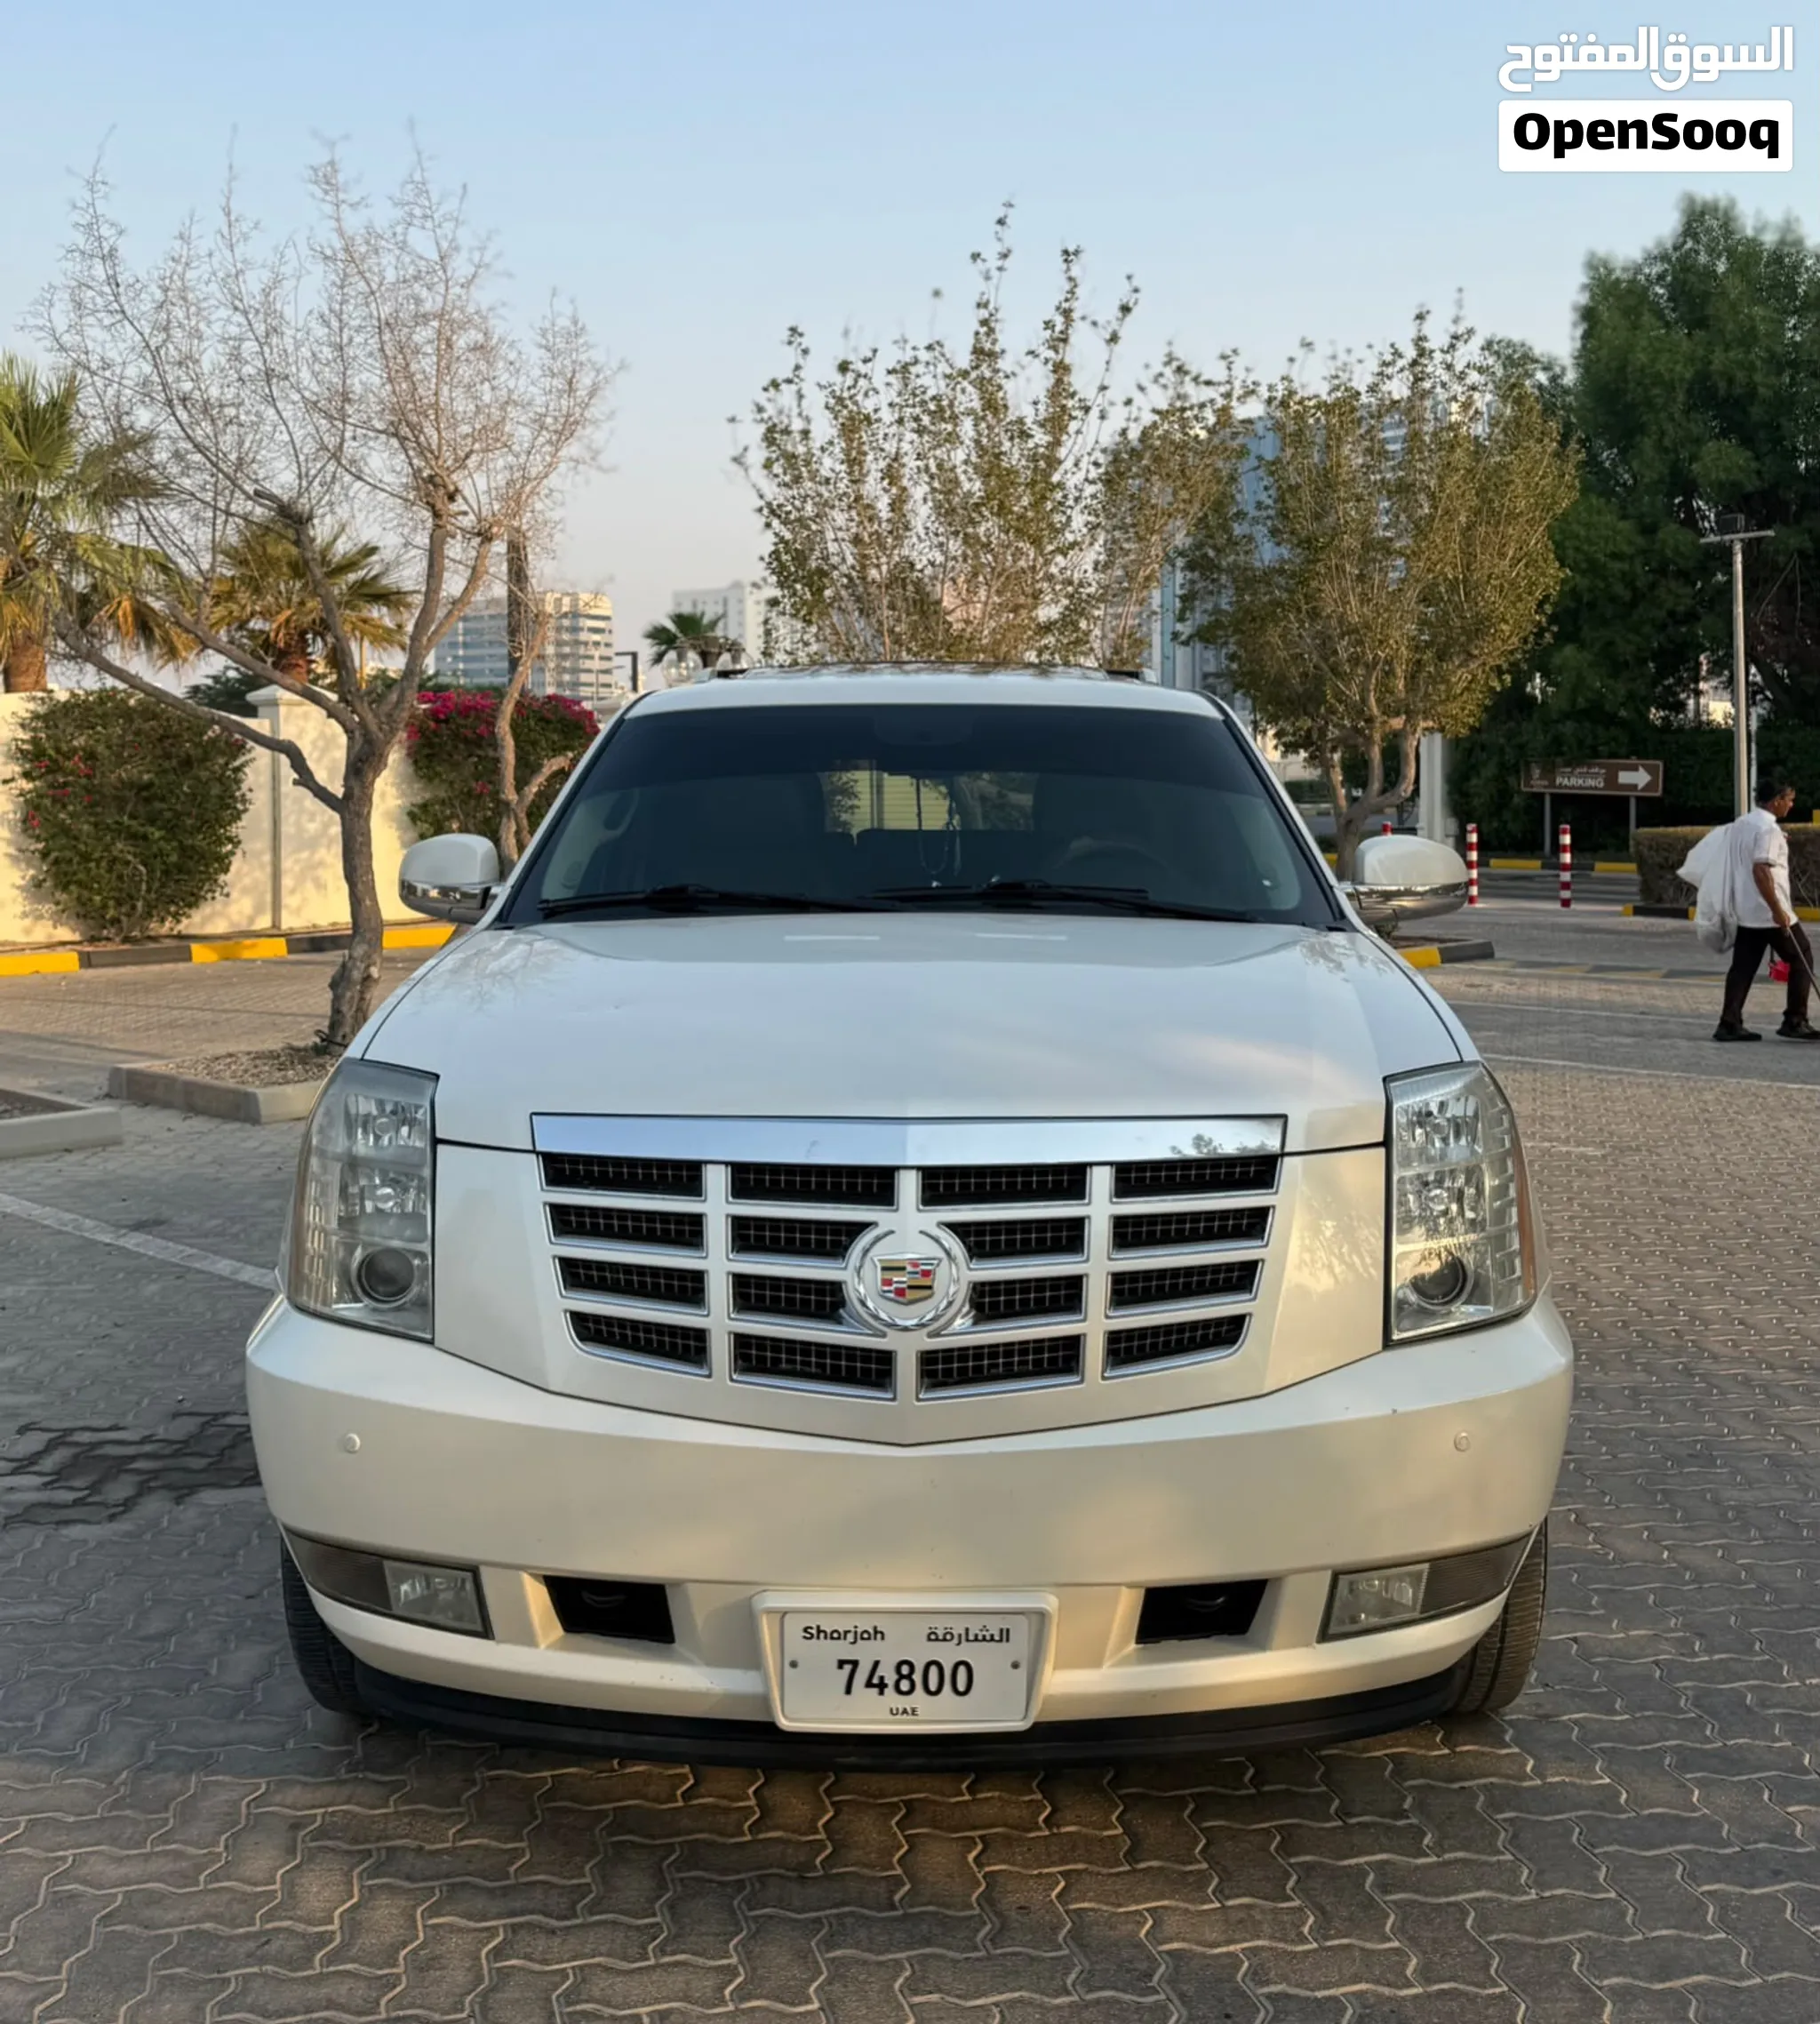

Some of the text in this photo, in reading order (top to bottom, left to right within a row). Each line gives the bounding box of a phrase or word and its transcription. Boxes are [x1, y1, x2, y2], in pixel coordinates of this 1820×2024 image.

[1555, 775, 1605, 788] PARKING
[802, 1625, 886, 1645] Sharjah
[926, 1624, 1011, 1646] الشارقة
[836, 1658, 974, 1697] 74800
[889, 1706, 919, 1717] UAE
